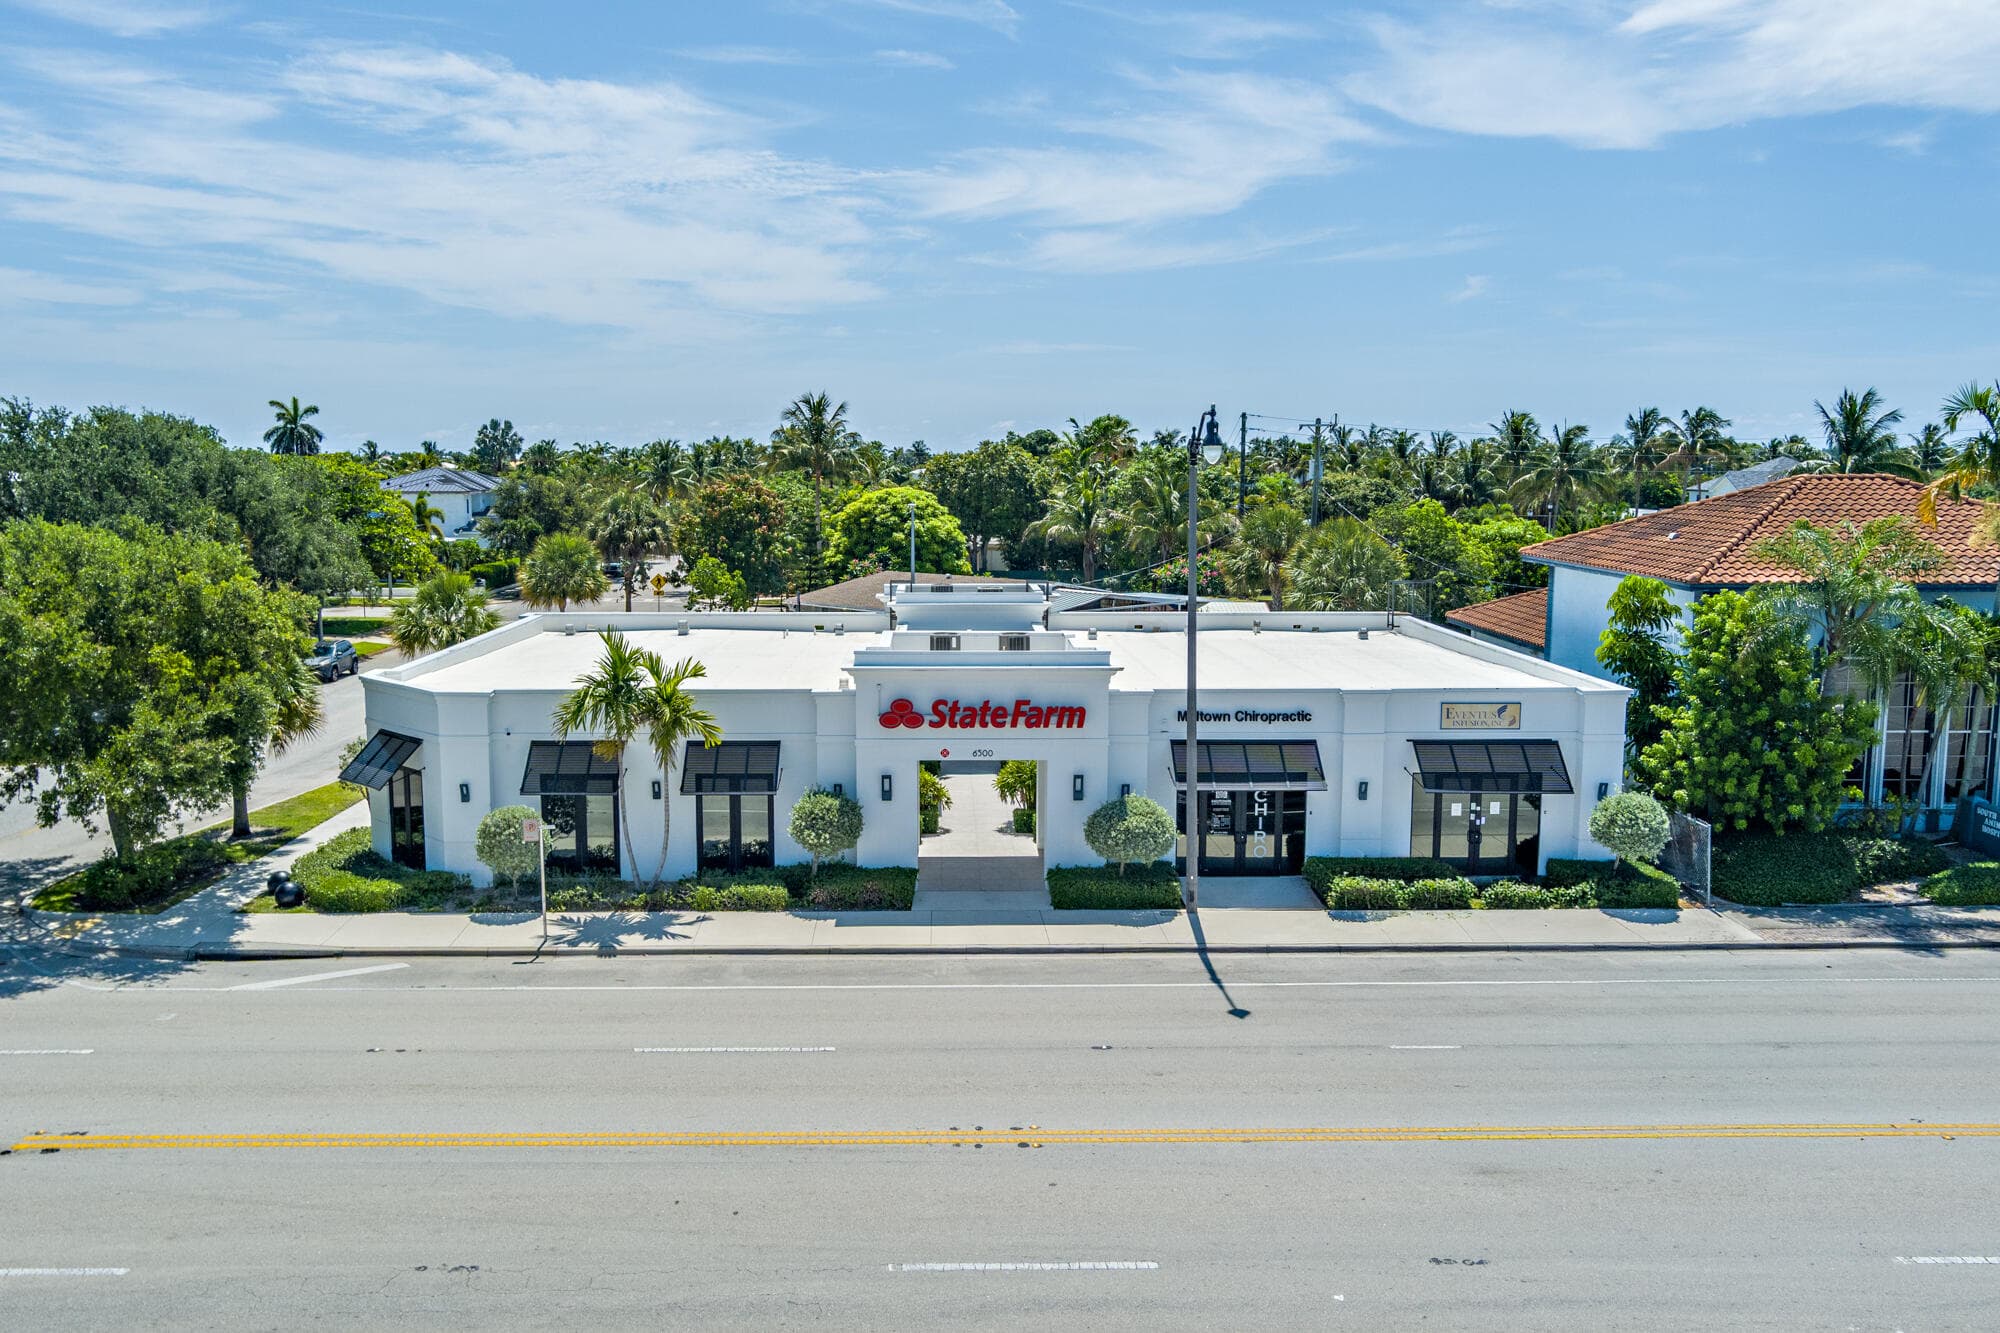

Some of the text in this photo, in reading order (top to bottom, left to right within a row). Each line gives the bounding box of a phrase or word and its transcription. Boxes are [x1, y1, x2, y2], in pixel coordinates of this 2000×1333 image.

[1234, 710, 1312, 724] Chiropractic
[972, 749, 994, 757] 6500
[1976, 806, 1997, 820] SOUTH
[1253, 790, 1268, 858] CHIRO
